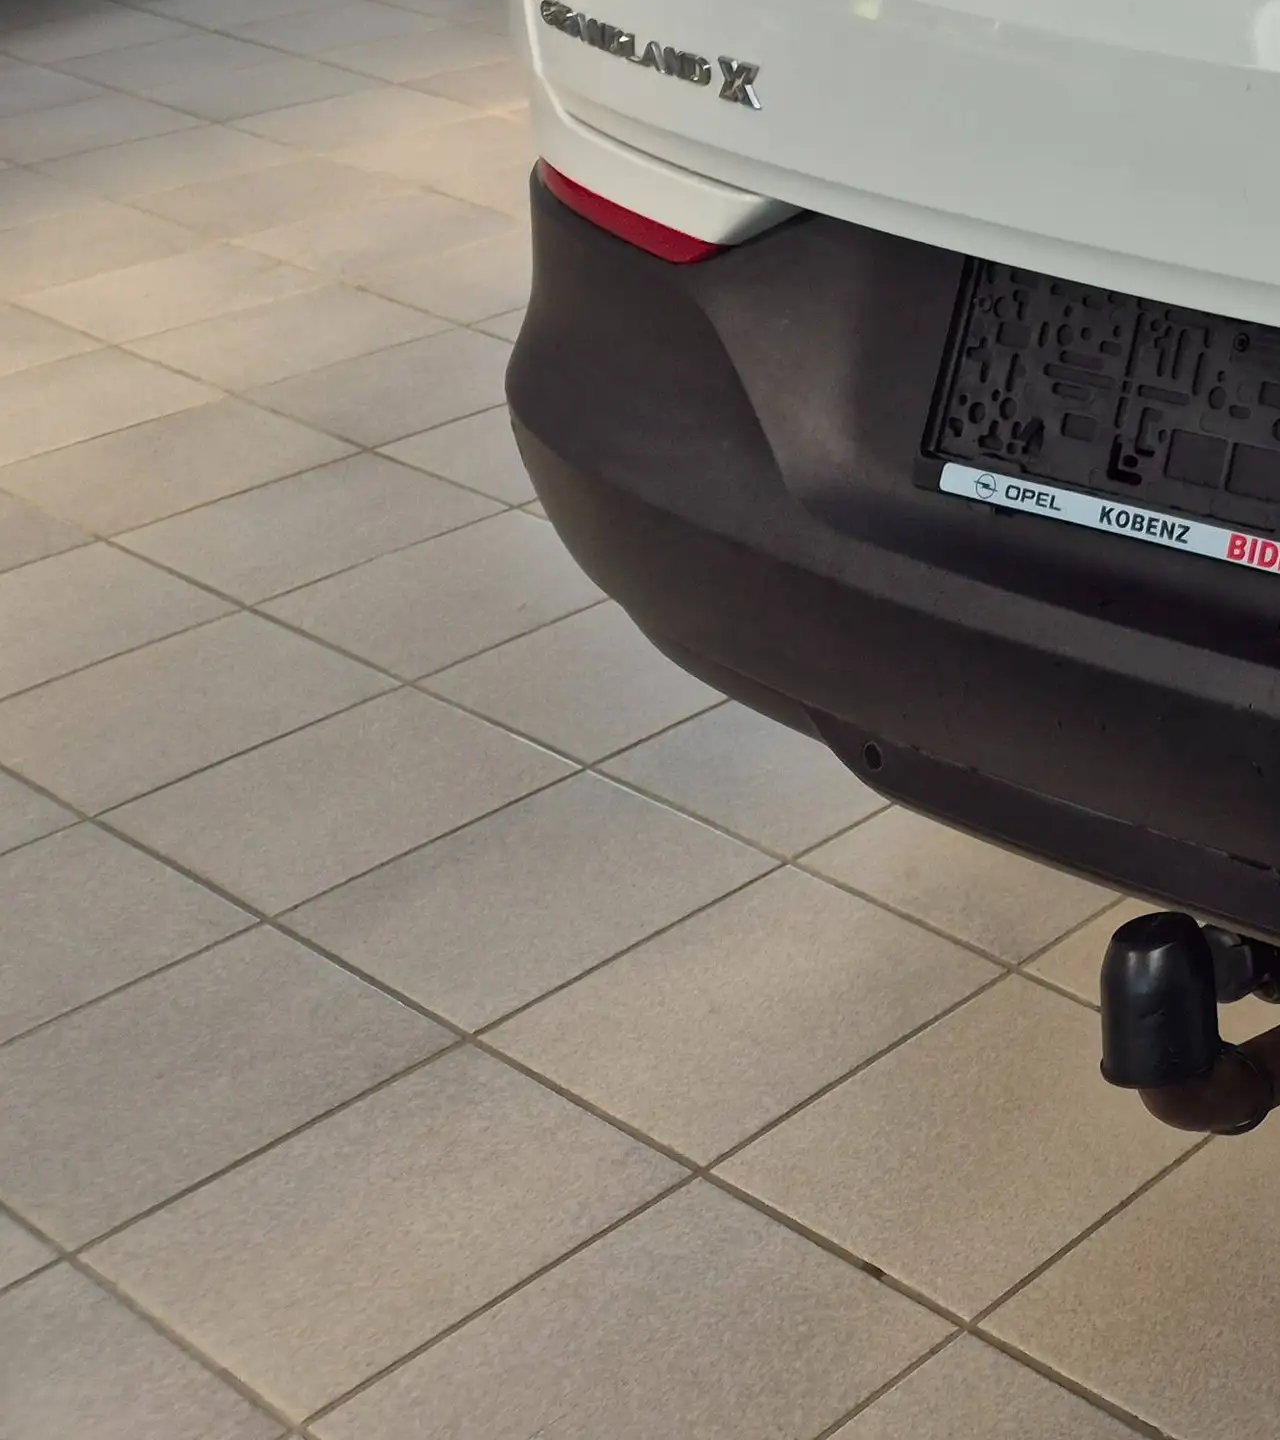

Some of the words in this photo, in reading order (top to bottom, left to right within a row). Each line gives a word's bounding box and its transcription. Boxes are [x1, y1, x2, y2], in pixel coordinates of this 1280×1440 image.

[717, 56, 762, 109] X
[1004, 483, 1062, 512] OPEL
[1099, 504, 1192, 545] KOBENZ
